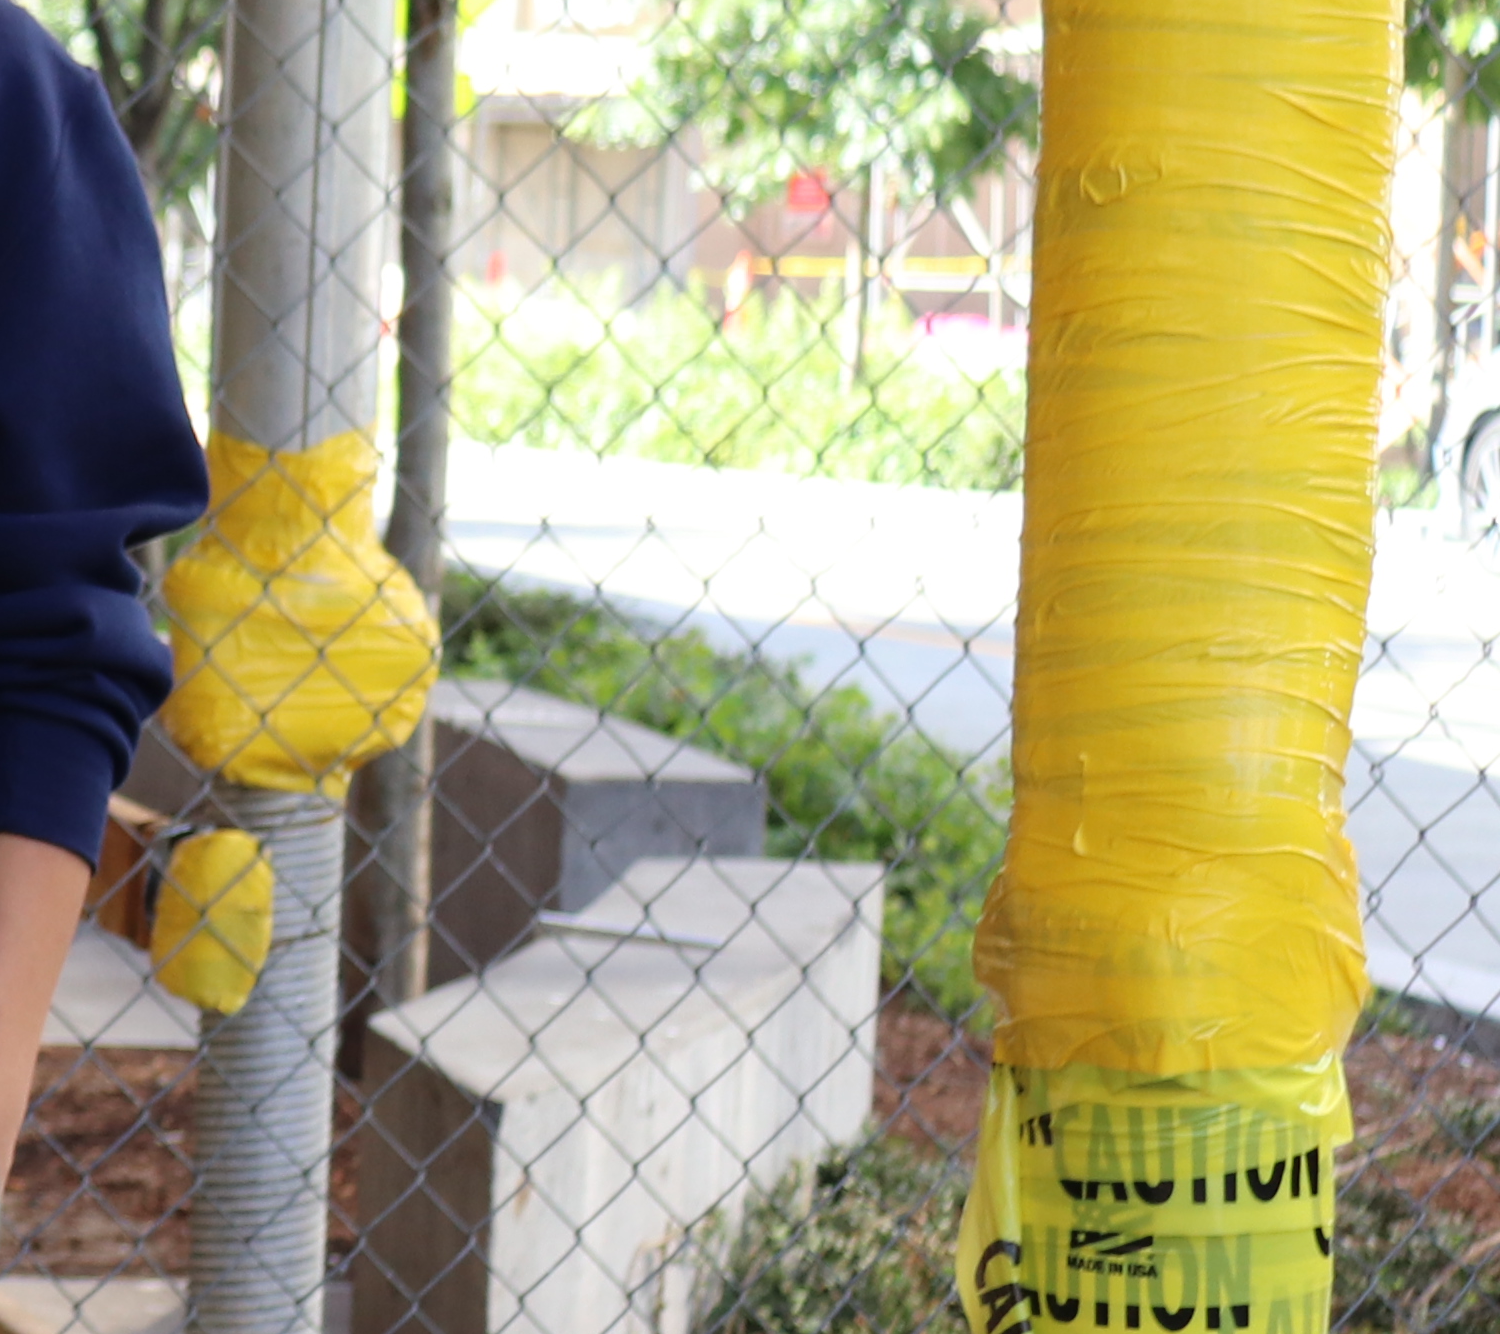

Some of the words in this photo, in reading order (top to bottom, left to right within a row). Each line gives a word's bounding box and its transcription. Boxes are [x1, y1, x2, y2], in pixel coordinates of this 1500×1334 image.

[1067, 1254, 1104, 1273] MADE
[1107, 1258, 1122, 1275] IN
[1127, 1260, 1159, 1278] USA
